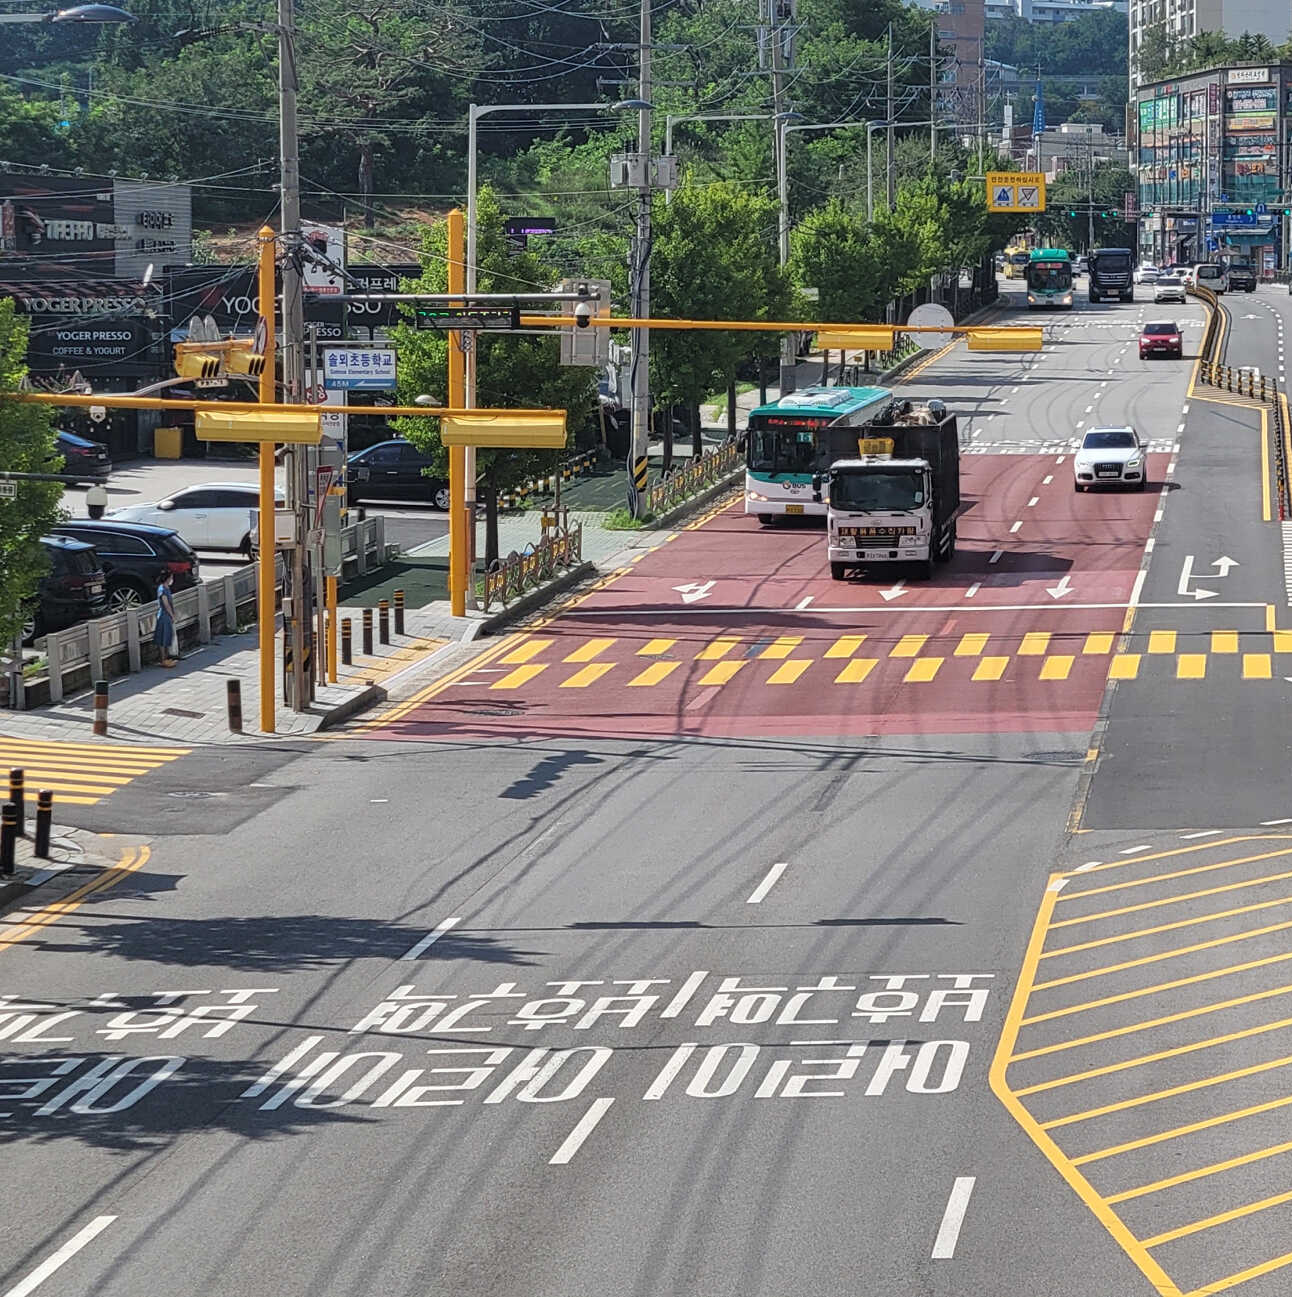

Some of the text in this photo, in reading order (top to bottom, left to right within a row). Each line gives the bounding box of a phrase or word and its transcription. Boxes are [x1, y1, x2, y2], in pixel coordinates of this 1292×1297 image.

[24, 298, 145, 313] YOGER PRESSO
[57, 331, 131, 341] YOGER PRESSO
[53, 347, 84, 355] COFFEE
[94, 347, 125, 355] YOGURT
[328, 353, 392, 367] 솔외초등학교
